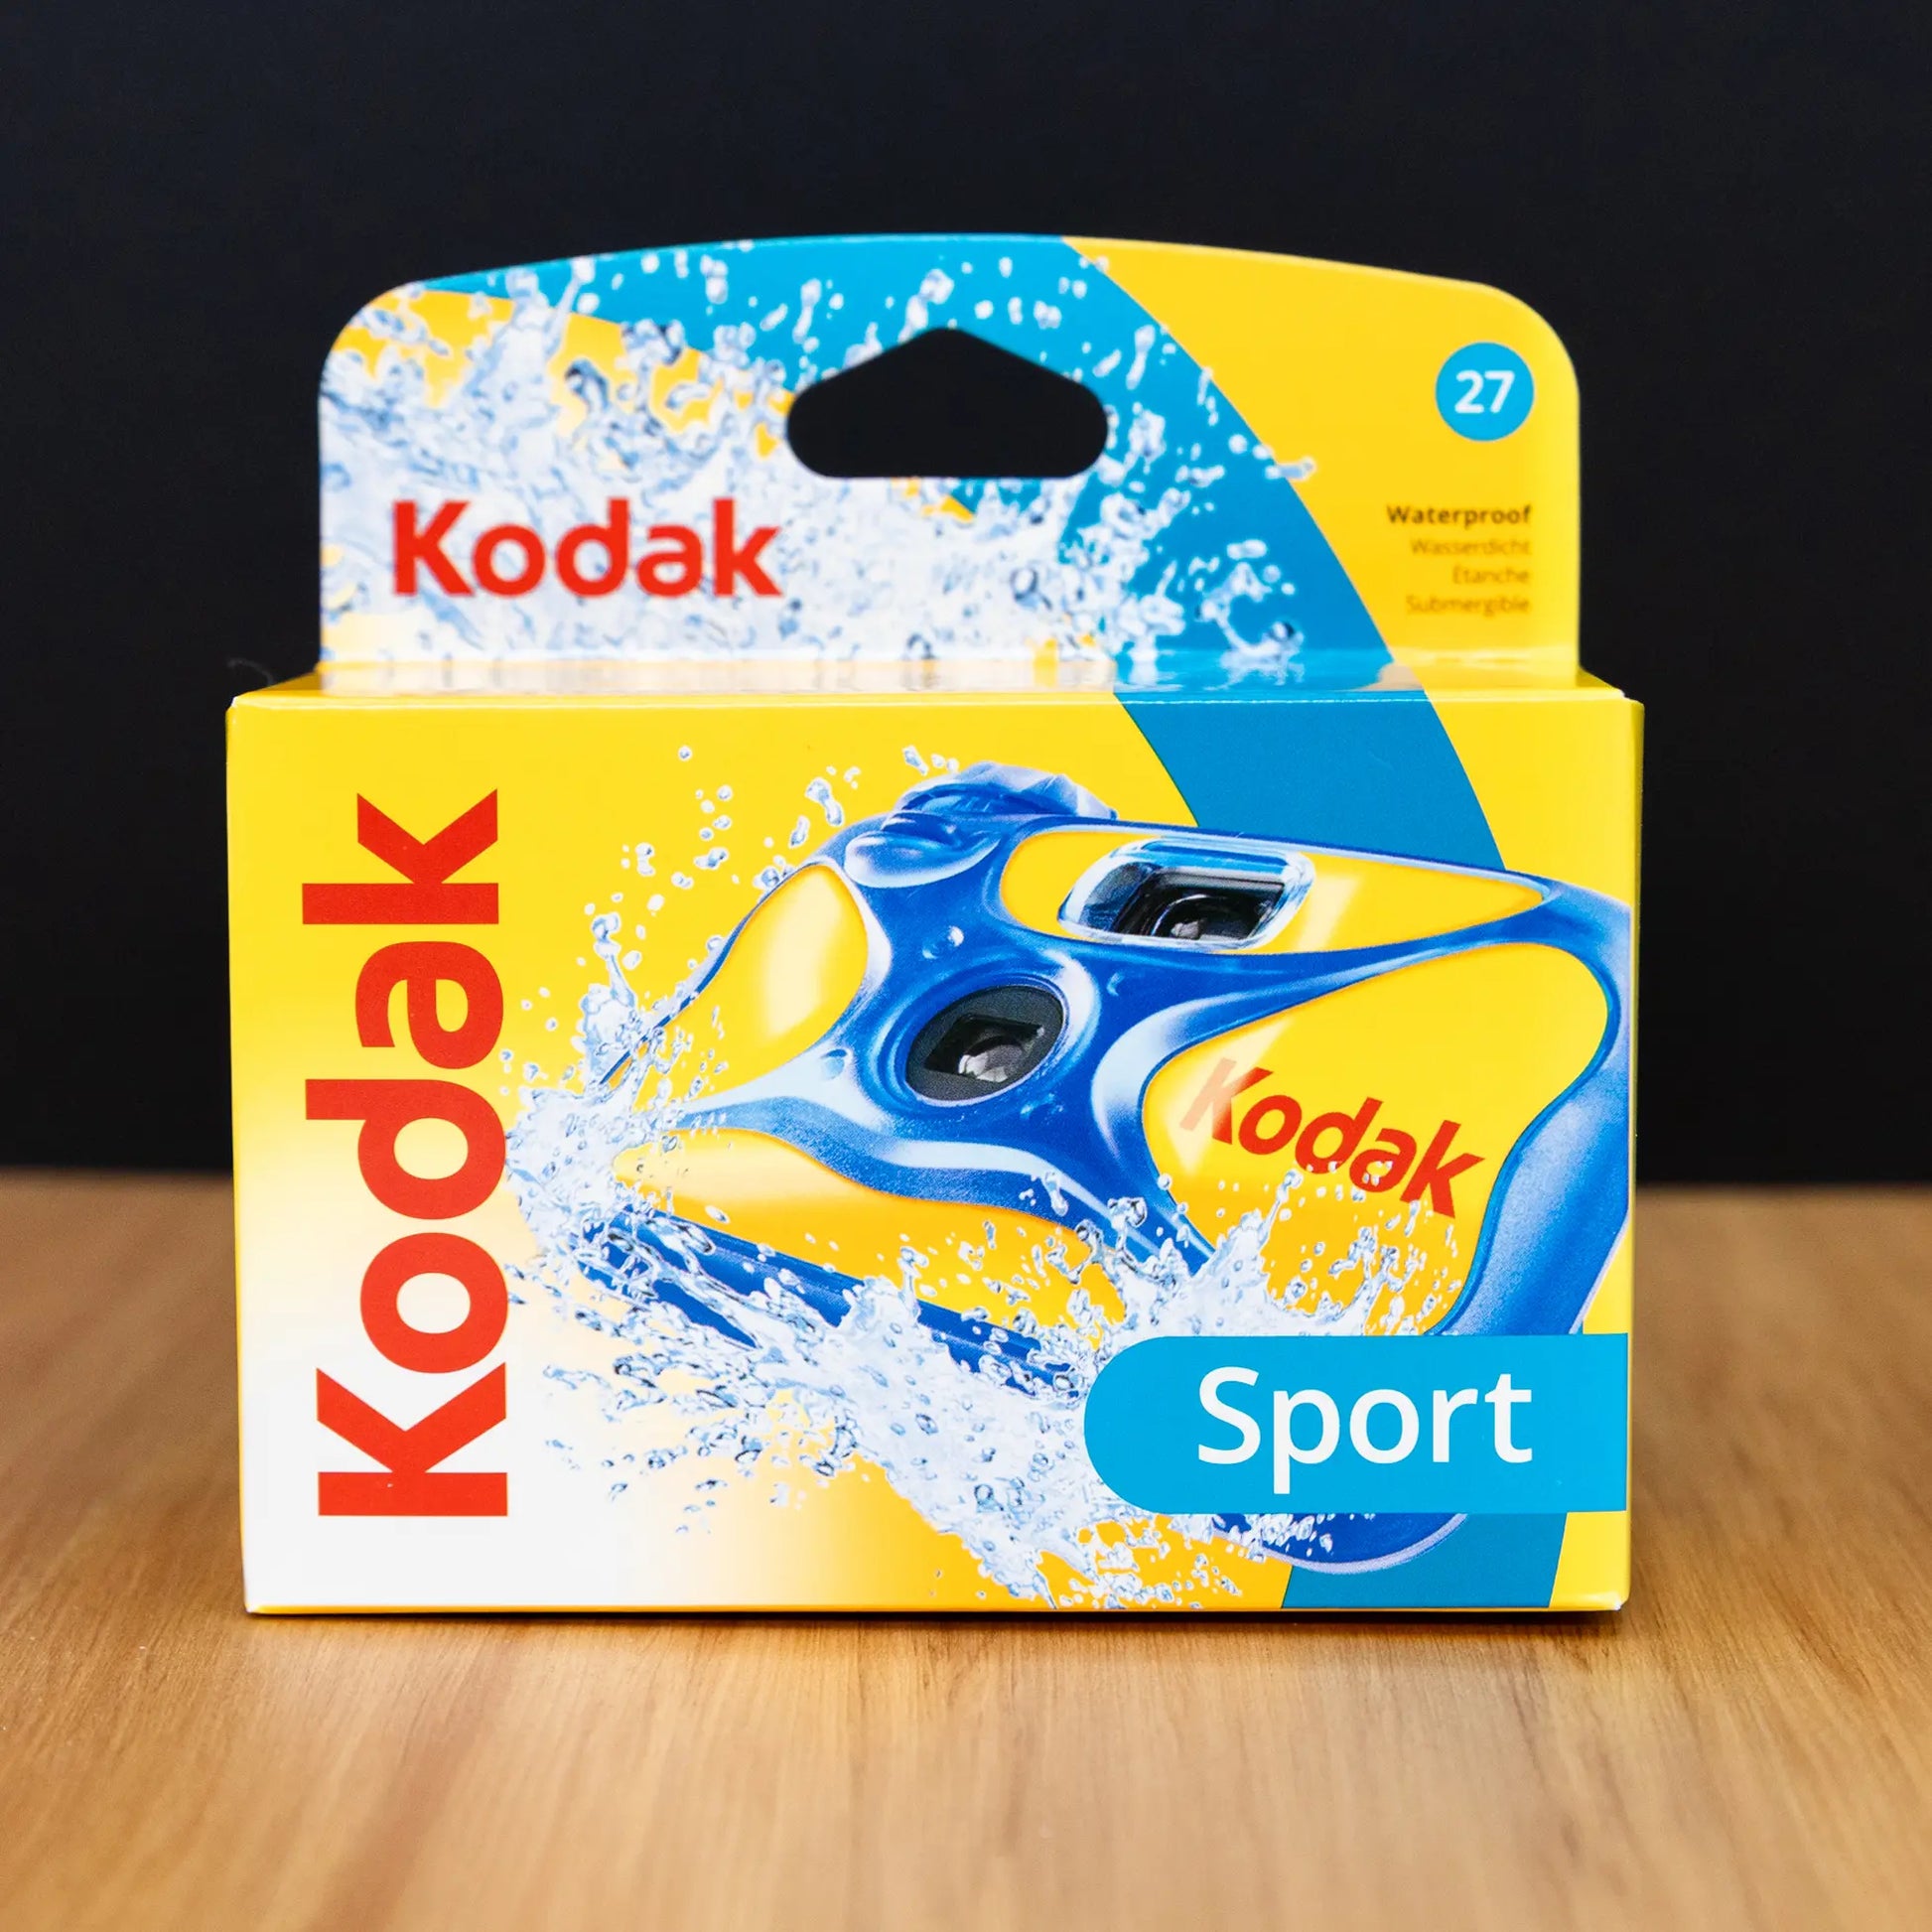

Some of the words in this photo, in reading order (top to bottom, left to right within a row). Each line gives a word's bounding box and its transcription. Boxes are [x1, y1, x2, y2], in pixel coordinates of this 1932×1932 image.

[1453, 369, 1516, 413] 27
[391, 498, 781, 598] Kodak
[1386, 504, 1533, 529] Waterproof
[1410, 538, 1531, 556] Wasserdicht
[1406, 595, 1530, 617] Submergible
[302, 788, 508, 1517] Kodak
[1178, 1057, 1486, 1219] Kodak
[1197, 1366, 1533, 1495] Sport
